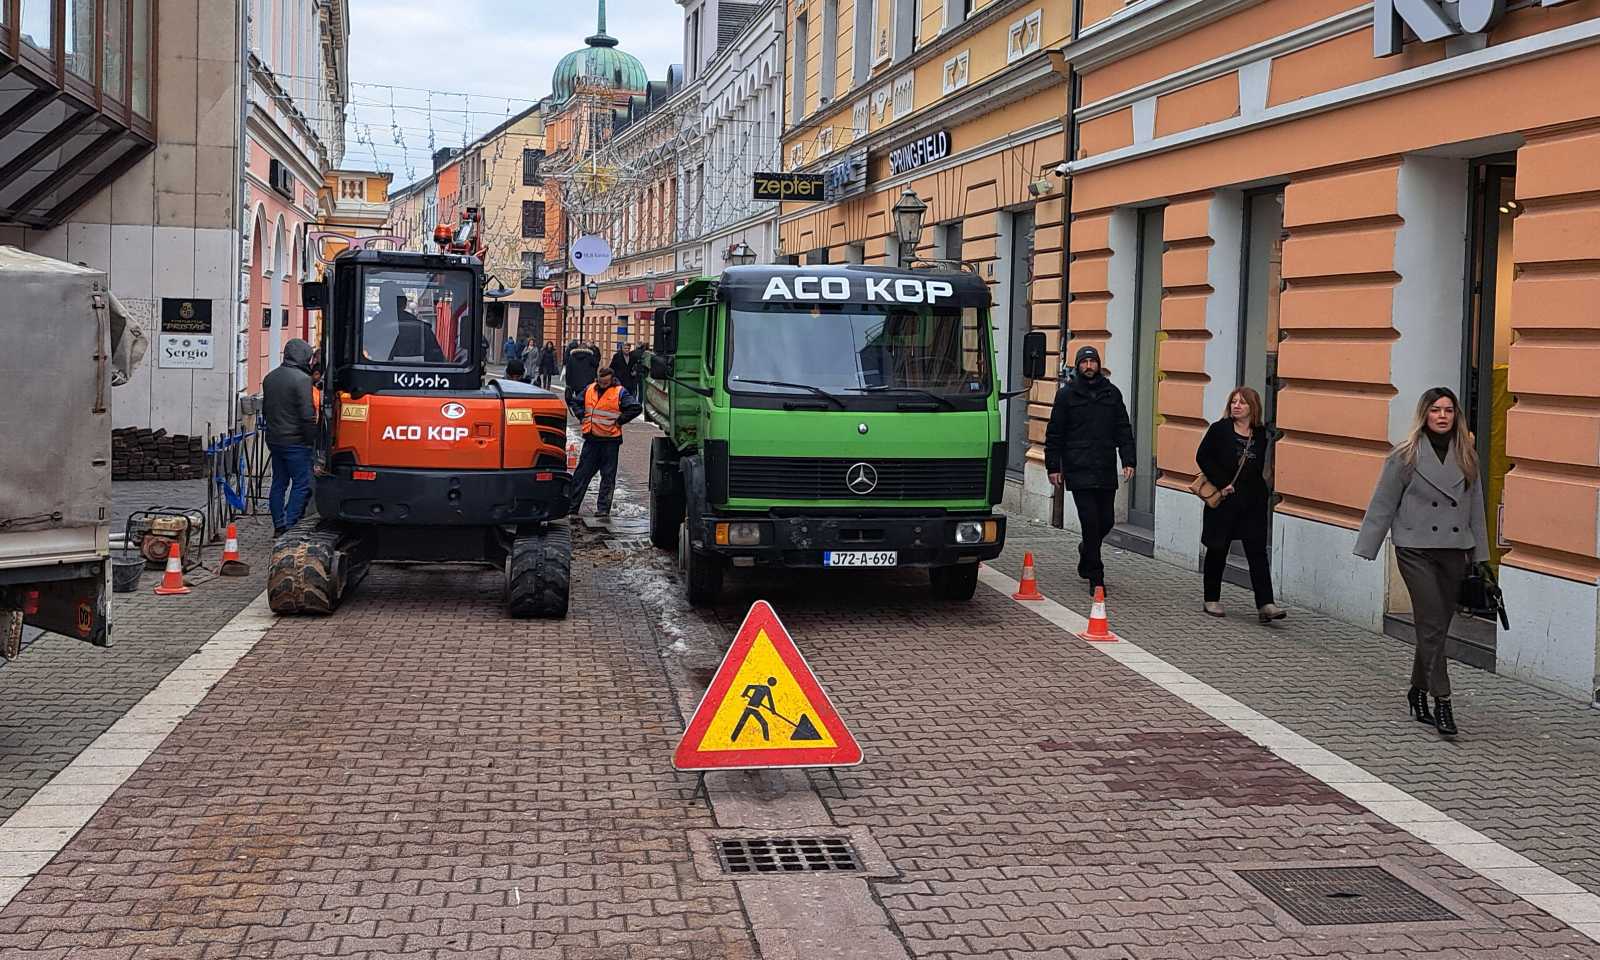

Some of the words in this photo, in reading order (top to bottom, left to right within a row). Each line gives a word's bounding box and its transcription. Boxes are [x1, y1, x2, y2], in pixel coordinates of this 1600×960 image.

[889, 131, 947, 176] SPRINGFIELD
[755, 174, 823, 199] zepter
[762, 276, 850, 300] ACO
[865, 277, 953, 304] KOP
[165, 347, 208, 360] Sergio
[393, 372, 450, 388] Kubota
[382, 425, 422, 440] ACO
[427, 425, 469, 441] KOP
[832, 552, 896, 565] J72-A-696
